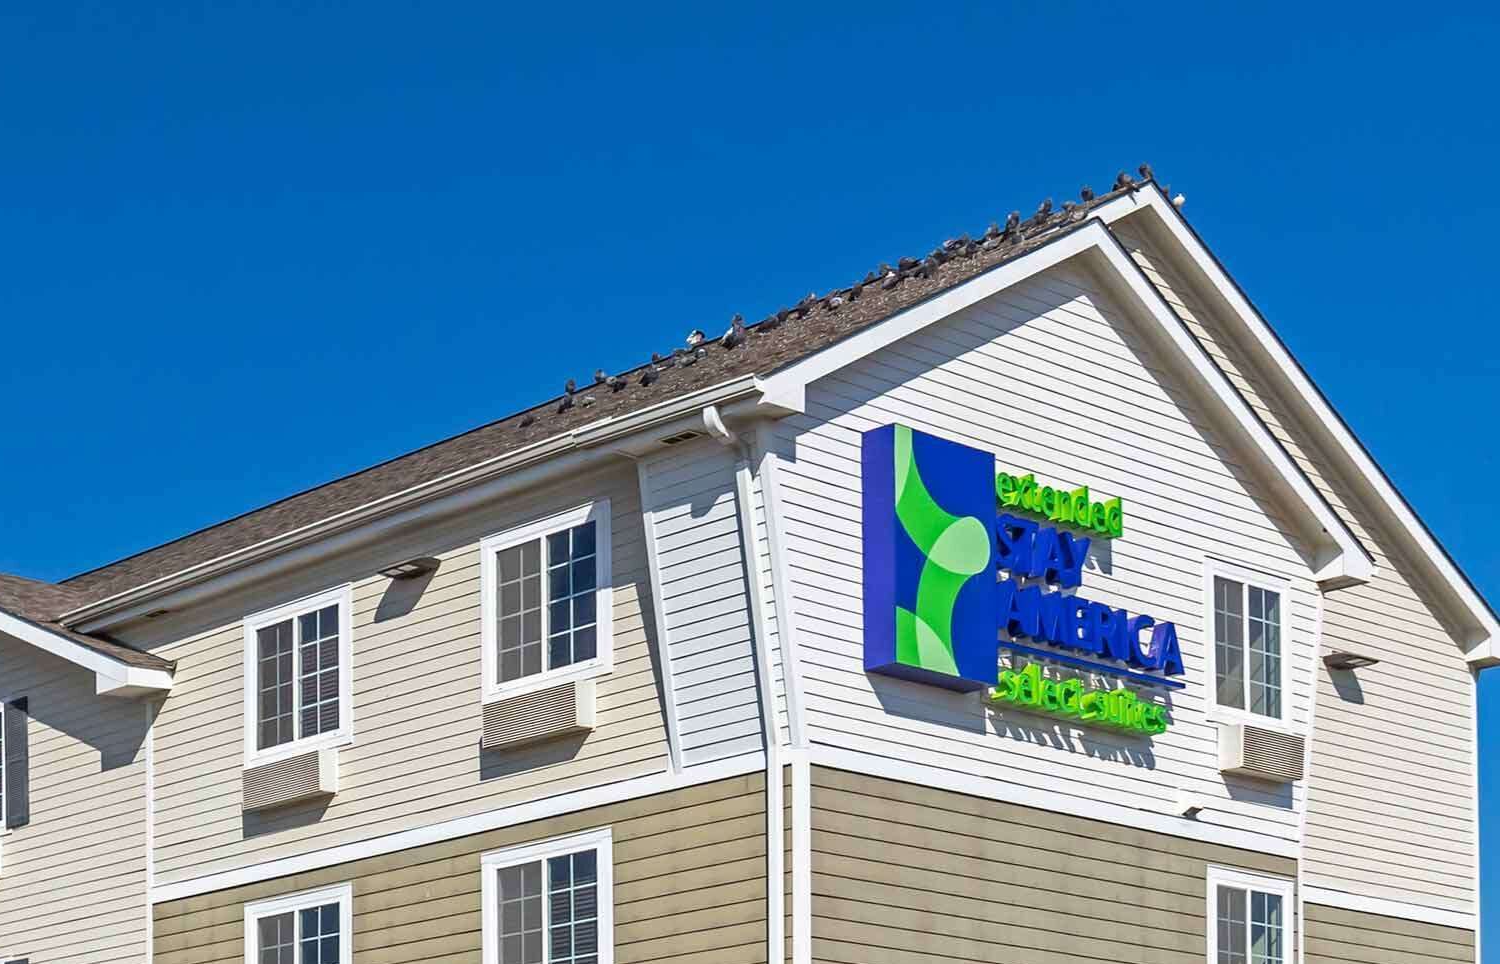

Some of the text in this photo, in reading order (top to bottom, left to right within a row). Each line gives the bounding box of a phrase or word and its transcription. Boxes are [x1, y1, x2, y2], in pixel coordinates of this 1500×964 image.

[996, 472, 1123, 538] extended
[996, 513, 1091, 588] STAY
[990, 664, 1167, 734] select suites
